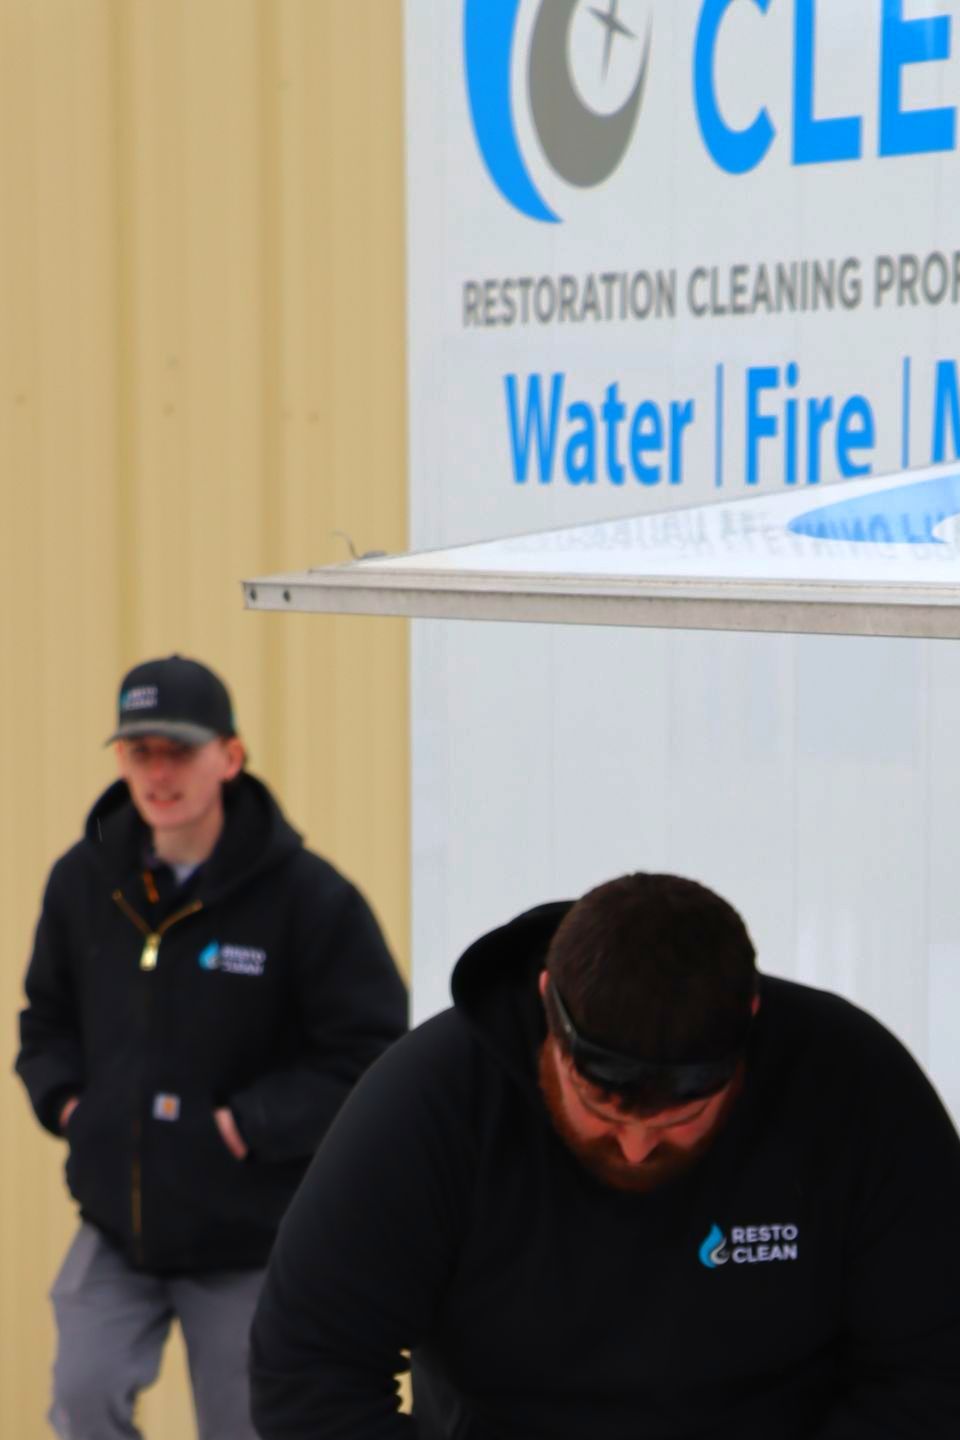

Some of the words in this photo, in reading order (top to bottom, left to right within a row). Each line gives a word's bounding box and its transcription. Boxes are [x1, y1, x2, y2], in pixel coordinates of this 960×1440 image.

[463, 268, 677, 326] RESTORATION
[688, 257, 861, 317] CLEANING
[503, 372, 694, 486] Water
[746, 361, 875, 486] Fire
[731, 1223, 799, 1244] RESTO
[731, 1244, 798, 1264] CLEAN
